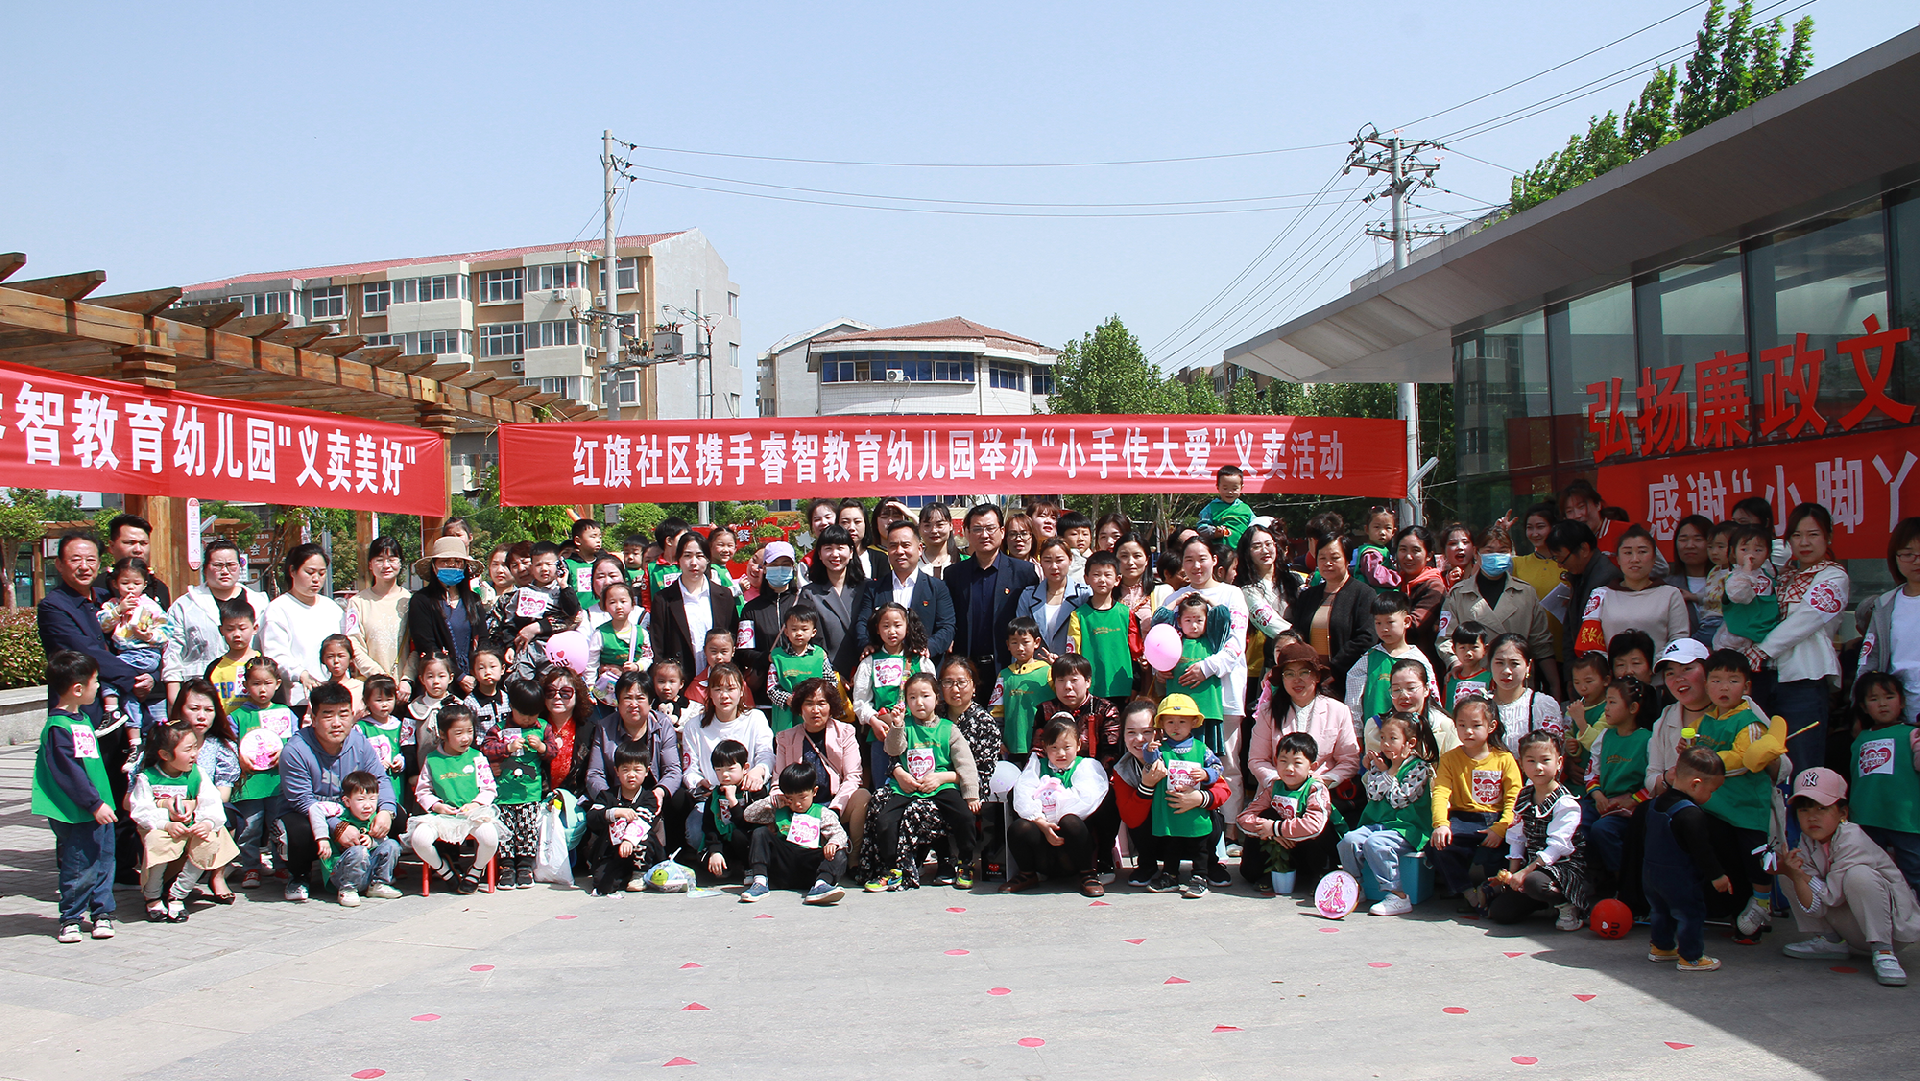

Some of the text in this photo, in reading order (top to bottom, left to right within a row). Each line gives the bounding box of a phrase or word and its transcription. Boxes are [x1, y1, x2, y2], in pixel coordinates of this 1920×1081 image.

[0, 381, 416, 496] 智教育幼儿园"义卖美好"
[1586, 313, 1916, 463] 弘扬廉政文
